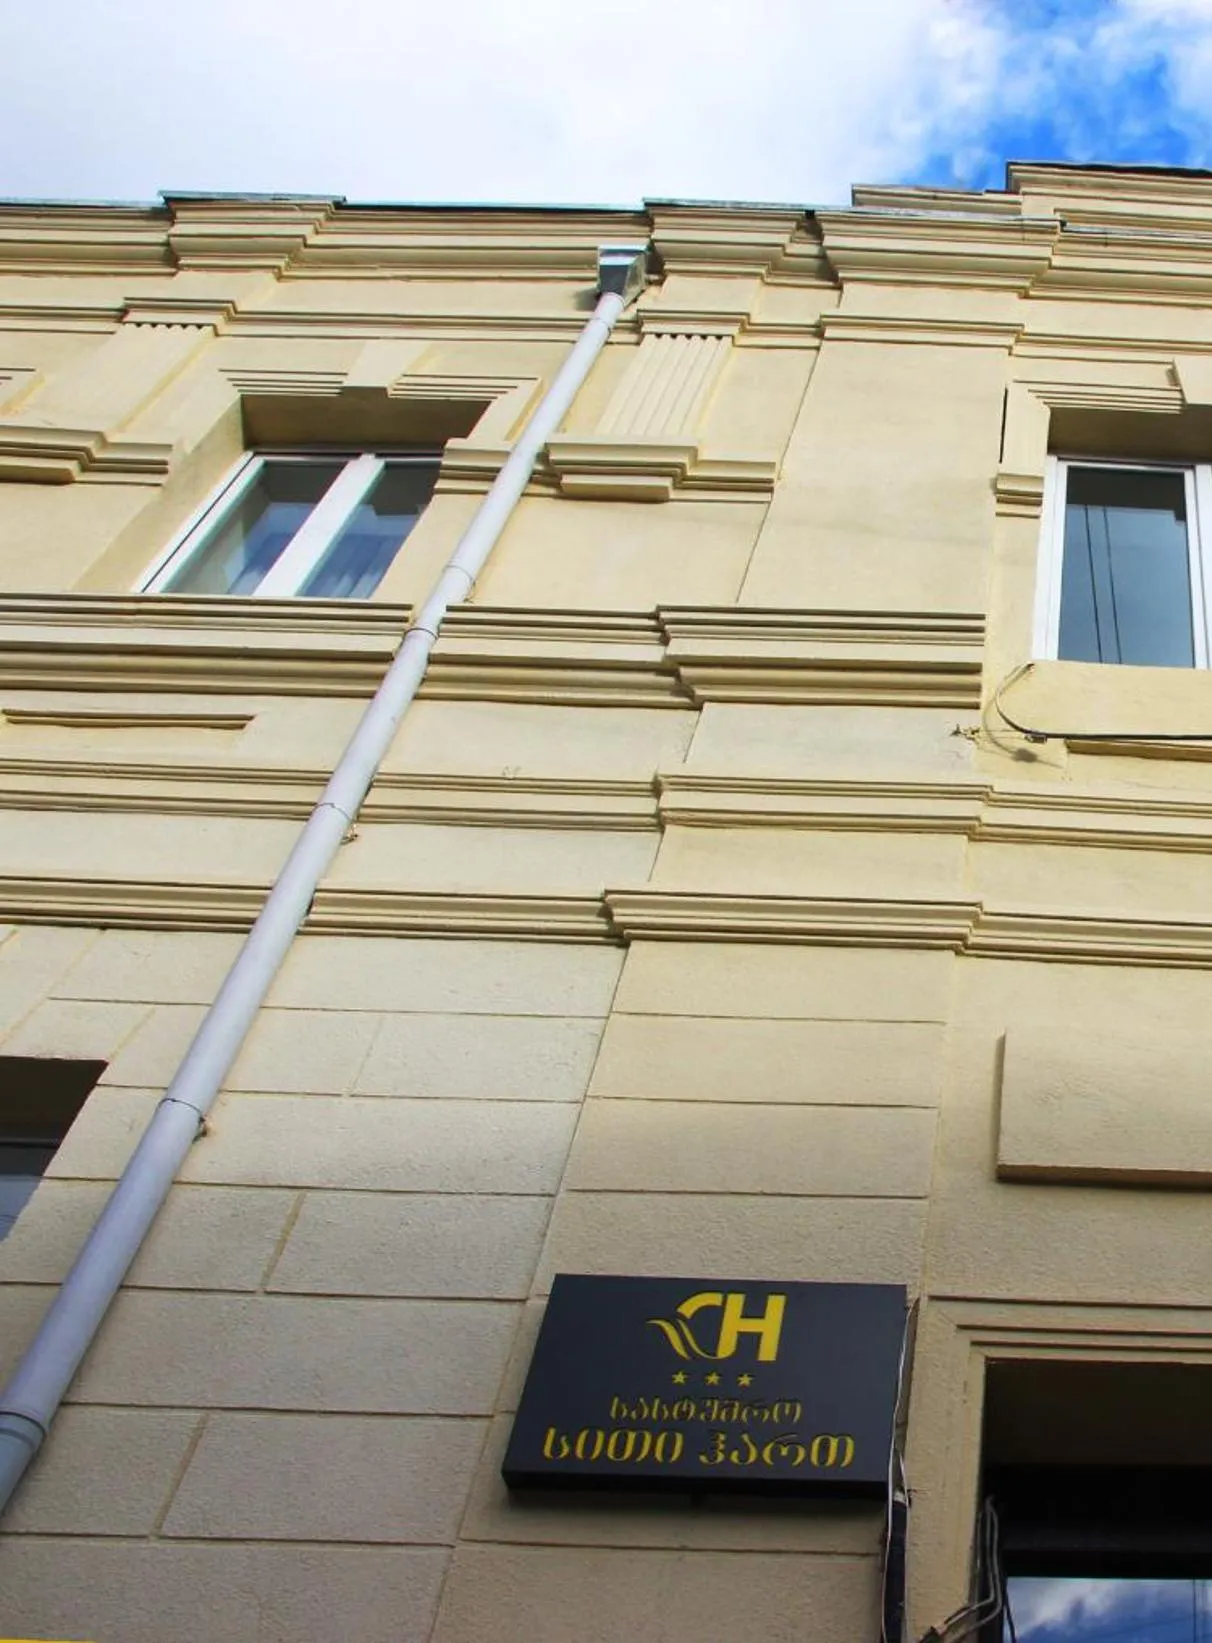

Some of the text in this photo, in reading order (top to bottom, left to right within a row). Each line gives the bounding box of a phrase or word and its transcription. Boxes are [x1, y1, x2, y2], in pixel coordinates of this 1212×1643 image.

[609, 1395, 802, 1424] სასტუმრო
[542, 1426, 855, 1468] სითი ჰართ
